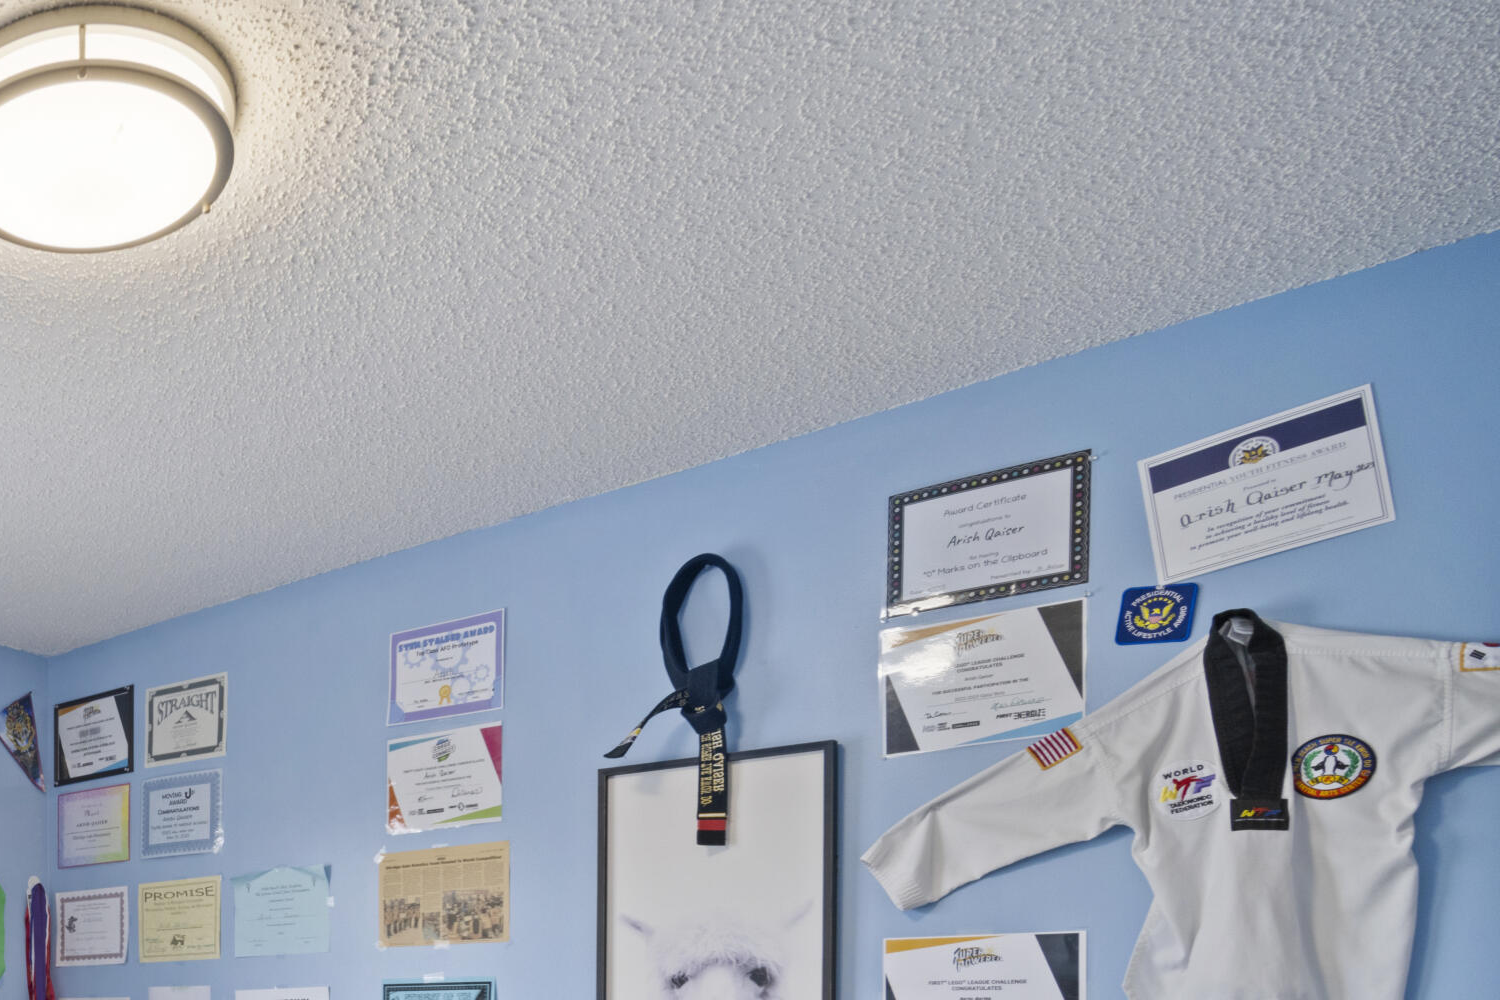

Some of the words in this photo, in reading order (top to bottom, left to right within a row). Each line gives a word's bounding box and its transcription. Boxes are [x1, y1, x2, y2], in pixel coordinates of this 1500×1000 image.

[1311, 441, 1347, 457] AWARD
[943, 504, 974, 518] Award
[976, 493, 1027, 510] Certificate
[947, 531, 980, 549] Arish
[984, 525, 1025, 540] Qaiser
[937, 564, 966, 577] Marks
[967, 562, 981, 570] on
[984, 558, 998, 567] the
[1000, 549, 1048, 565] Clipboard
[1131, 590, 1184, 607] PRESIDENTIAL
[463, 625, 495, 639] AWARD
[1132, 626, 1174, 639] LIFESTYLE
[157, 690, 217, 726] STRAIGHT
[174, 710, 197, 724] A
[1162, 764, 1204, 780] WORLD
[144, 885, 215, 902] PROMISE
